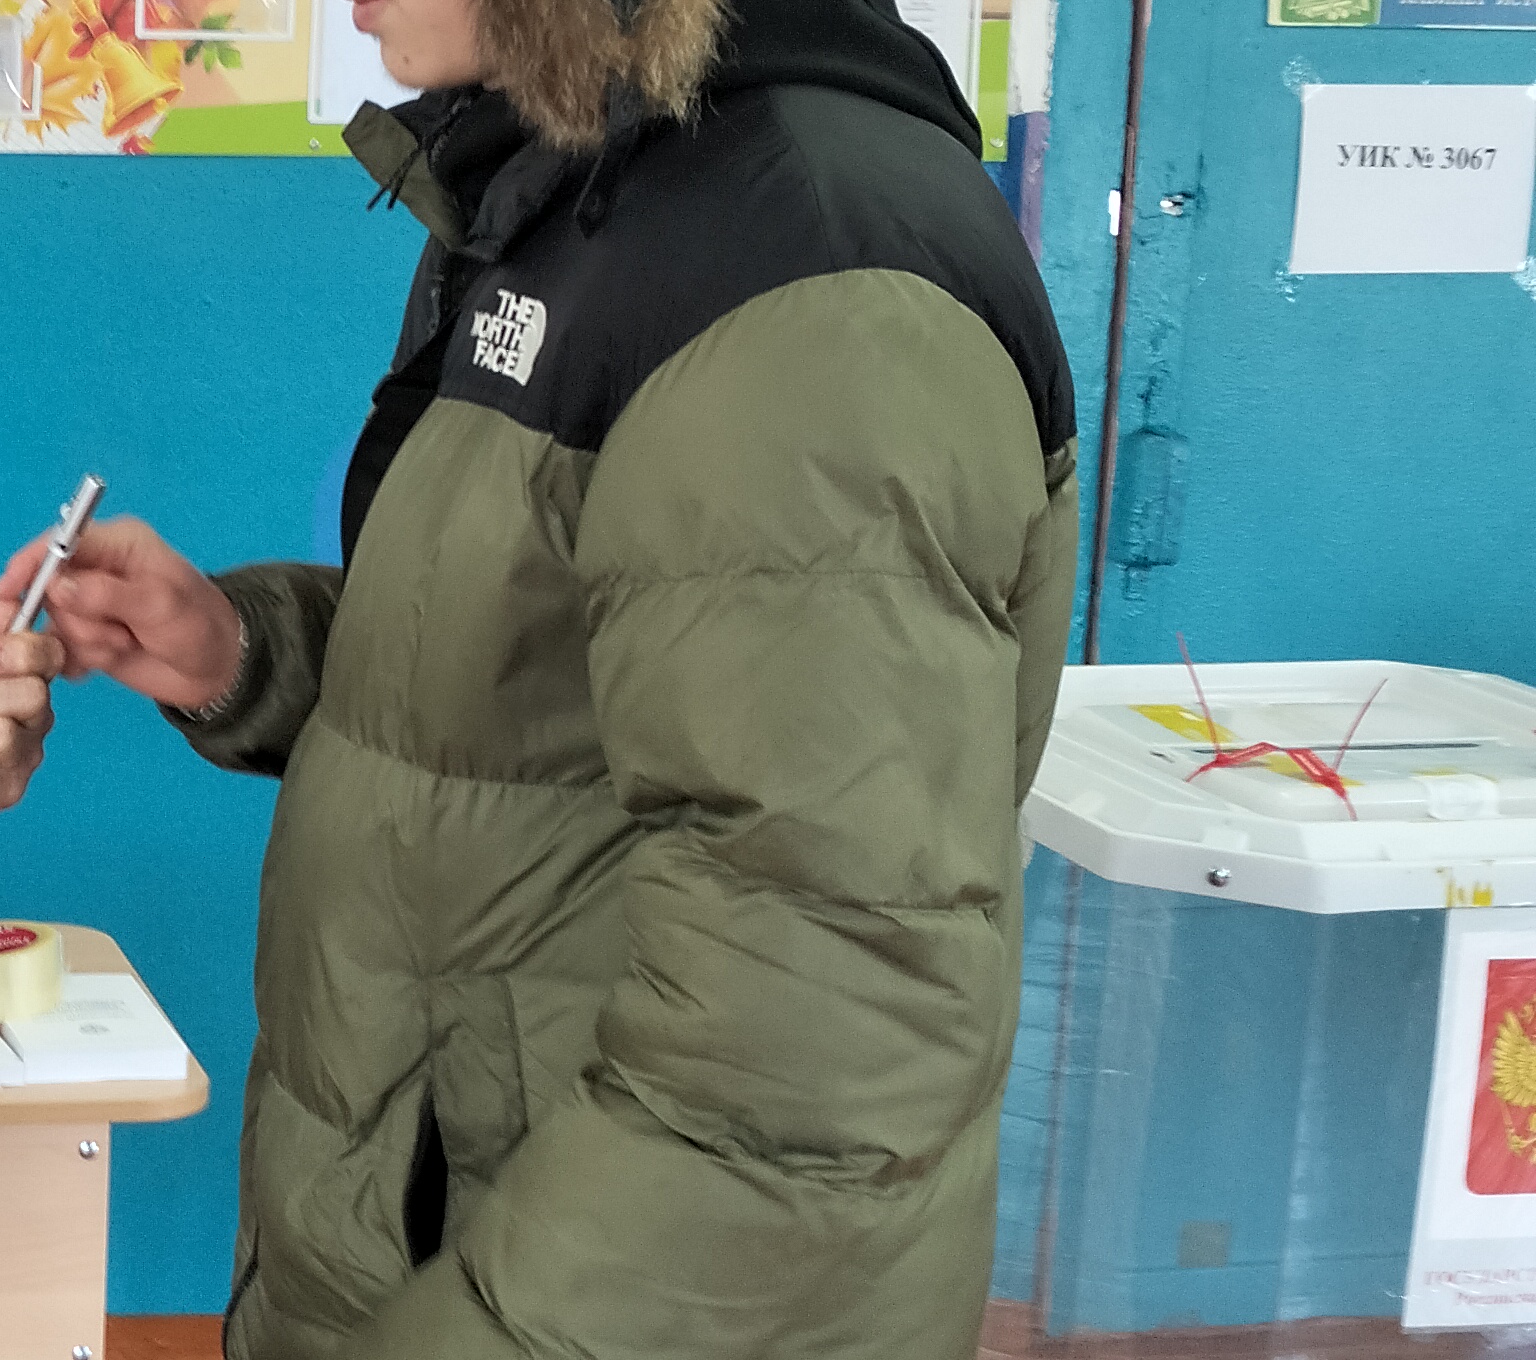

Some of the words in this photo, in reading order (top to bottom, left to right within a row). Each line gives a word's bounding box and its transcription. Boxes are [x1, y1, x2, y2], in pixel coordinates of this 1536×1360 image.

[1337, 144, 1401, 168] УИК
[1404, 146, 1435, 168] №
[1438, 146, 1499, 170] 3067
[497, 288, 536, 324] THE
[470, 311, 528, 352] NORTH
[472, 339, 522, 378] FACE
